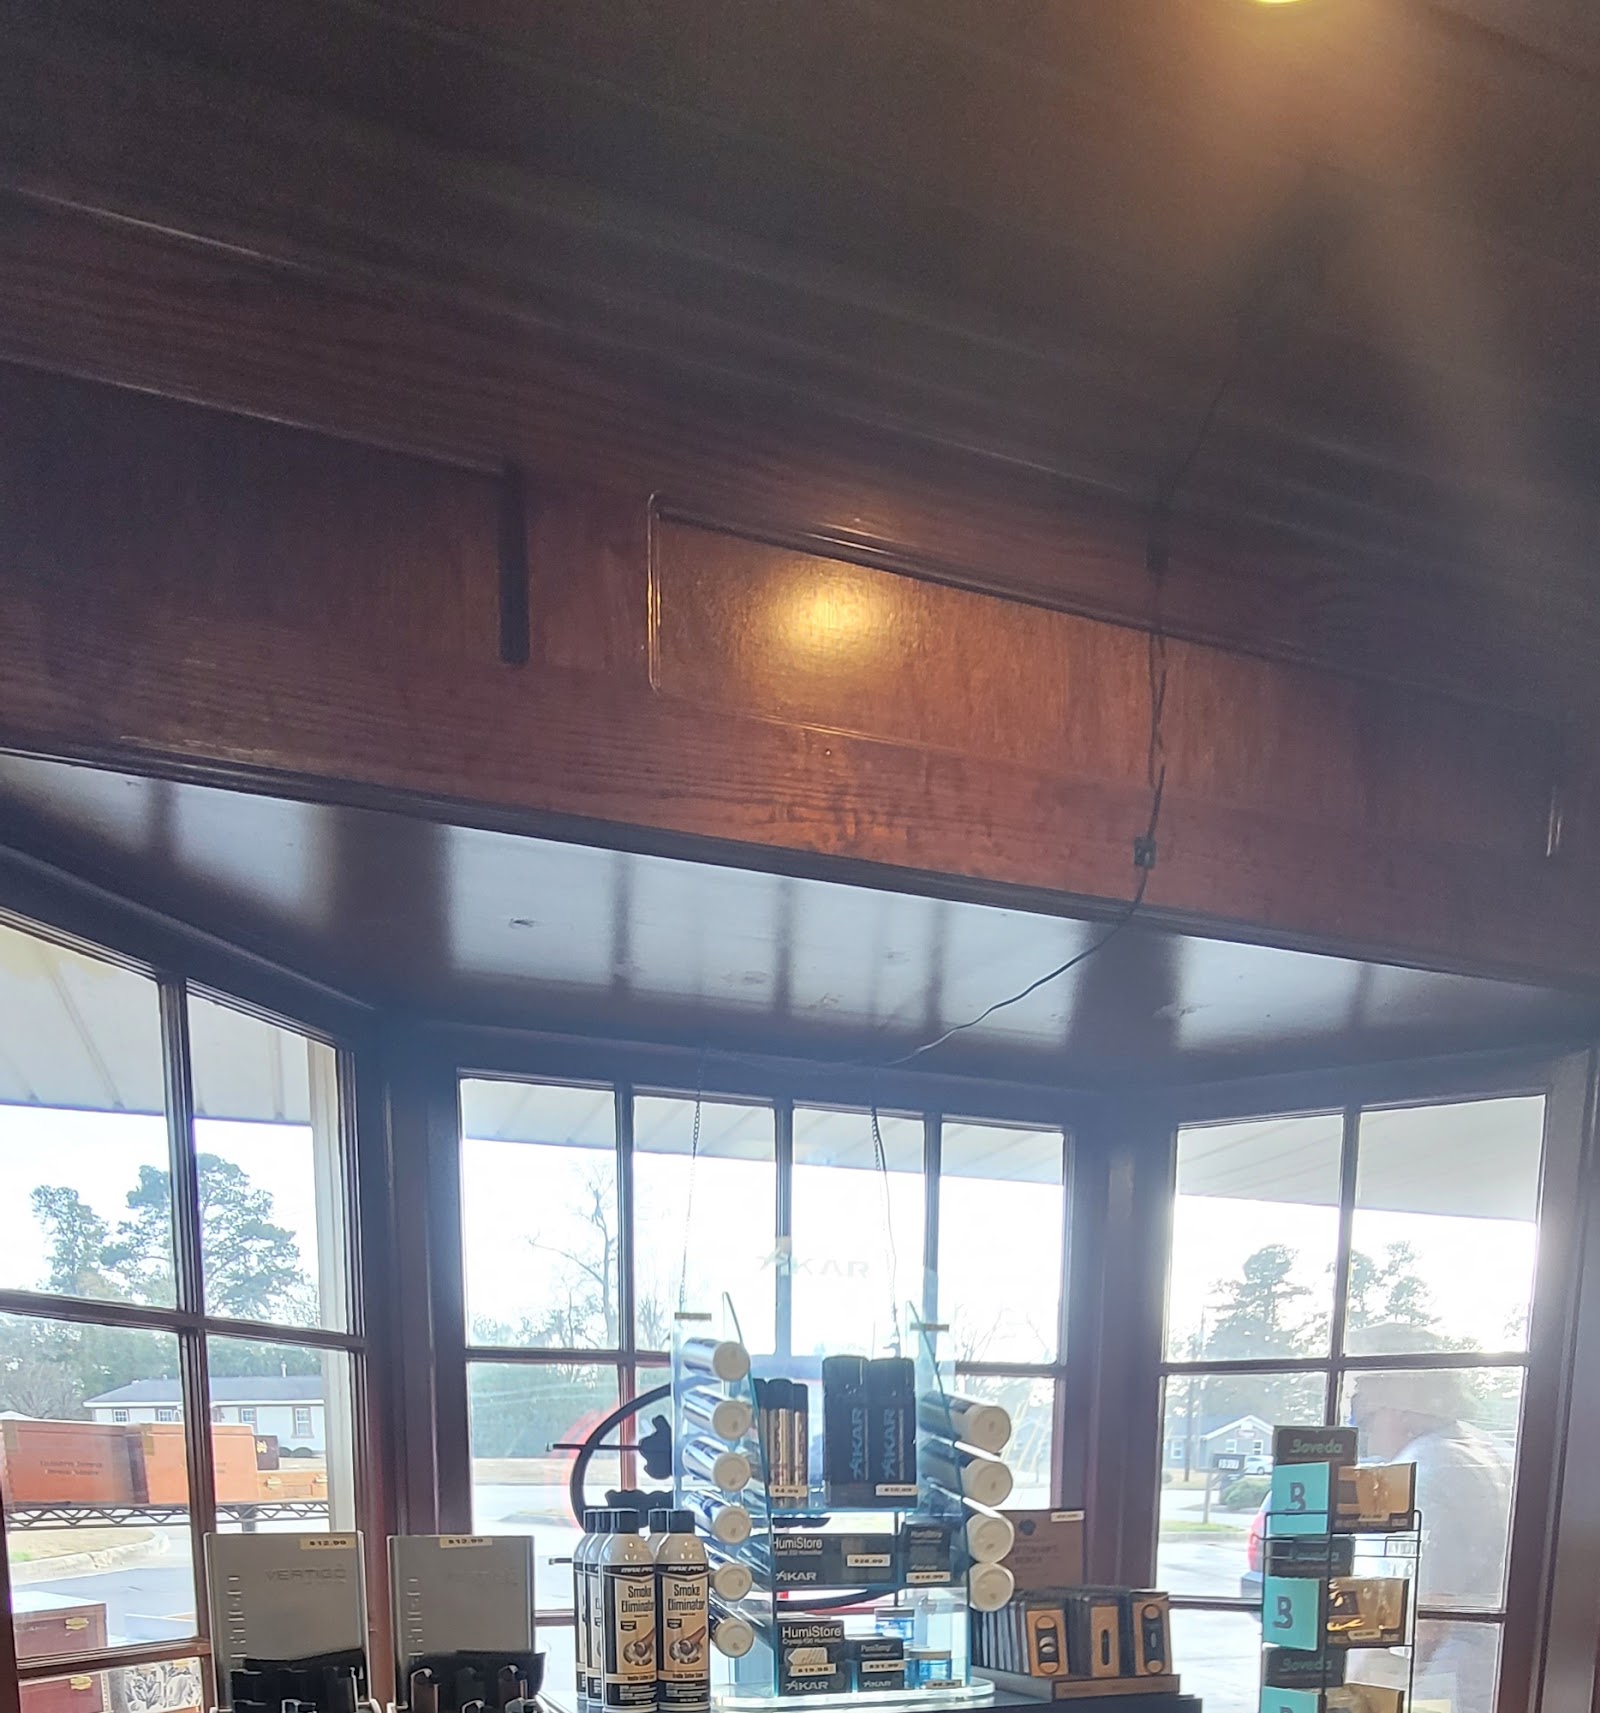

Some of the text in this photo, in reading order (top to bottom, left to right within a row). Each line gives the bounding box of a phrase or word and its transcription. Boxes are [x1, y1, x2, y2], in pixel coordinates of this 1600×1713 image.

[776, 1570, 817, 1581] XIKAR
[674, 1584, 700, 1597] Smoke
[668, 1599, 705, 1611] Eliminator
[1273, 1596, 1293, 1629] B
[782, 1625, 842, 1638] HumiStore
[785, 1680, 829, 1691] XIKAR
[863, 1680, 892, 1688] XIKAR
